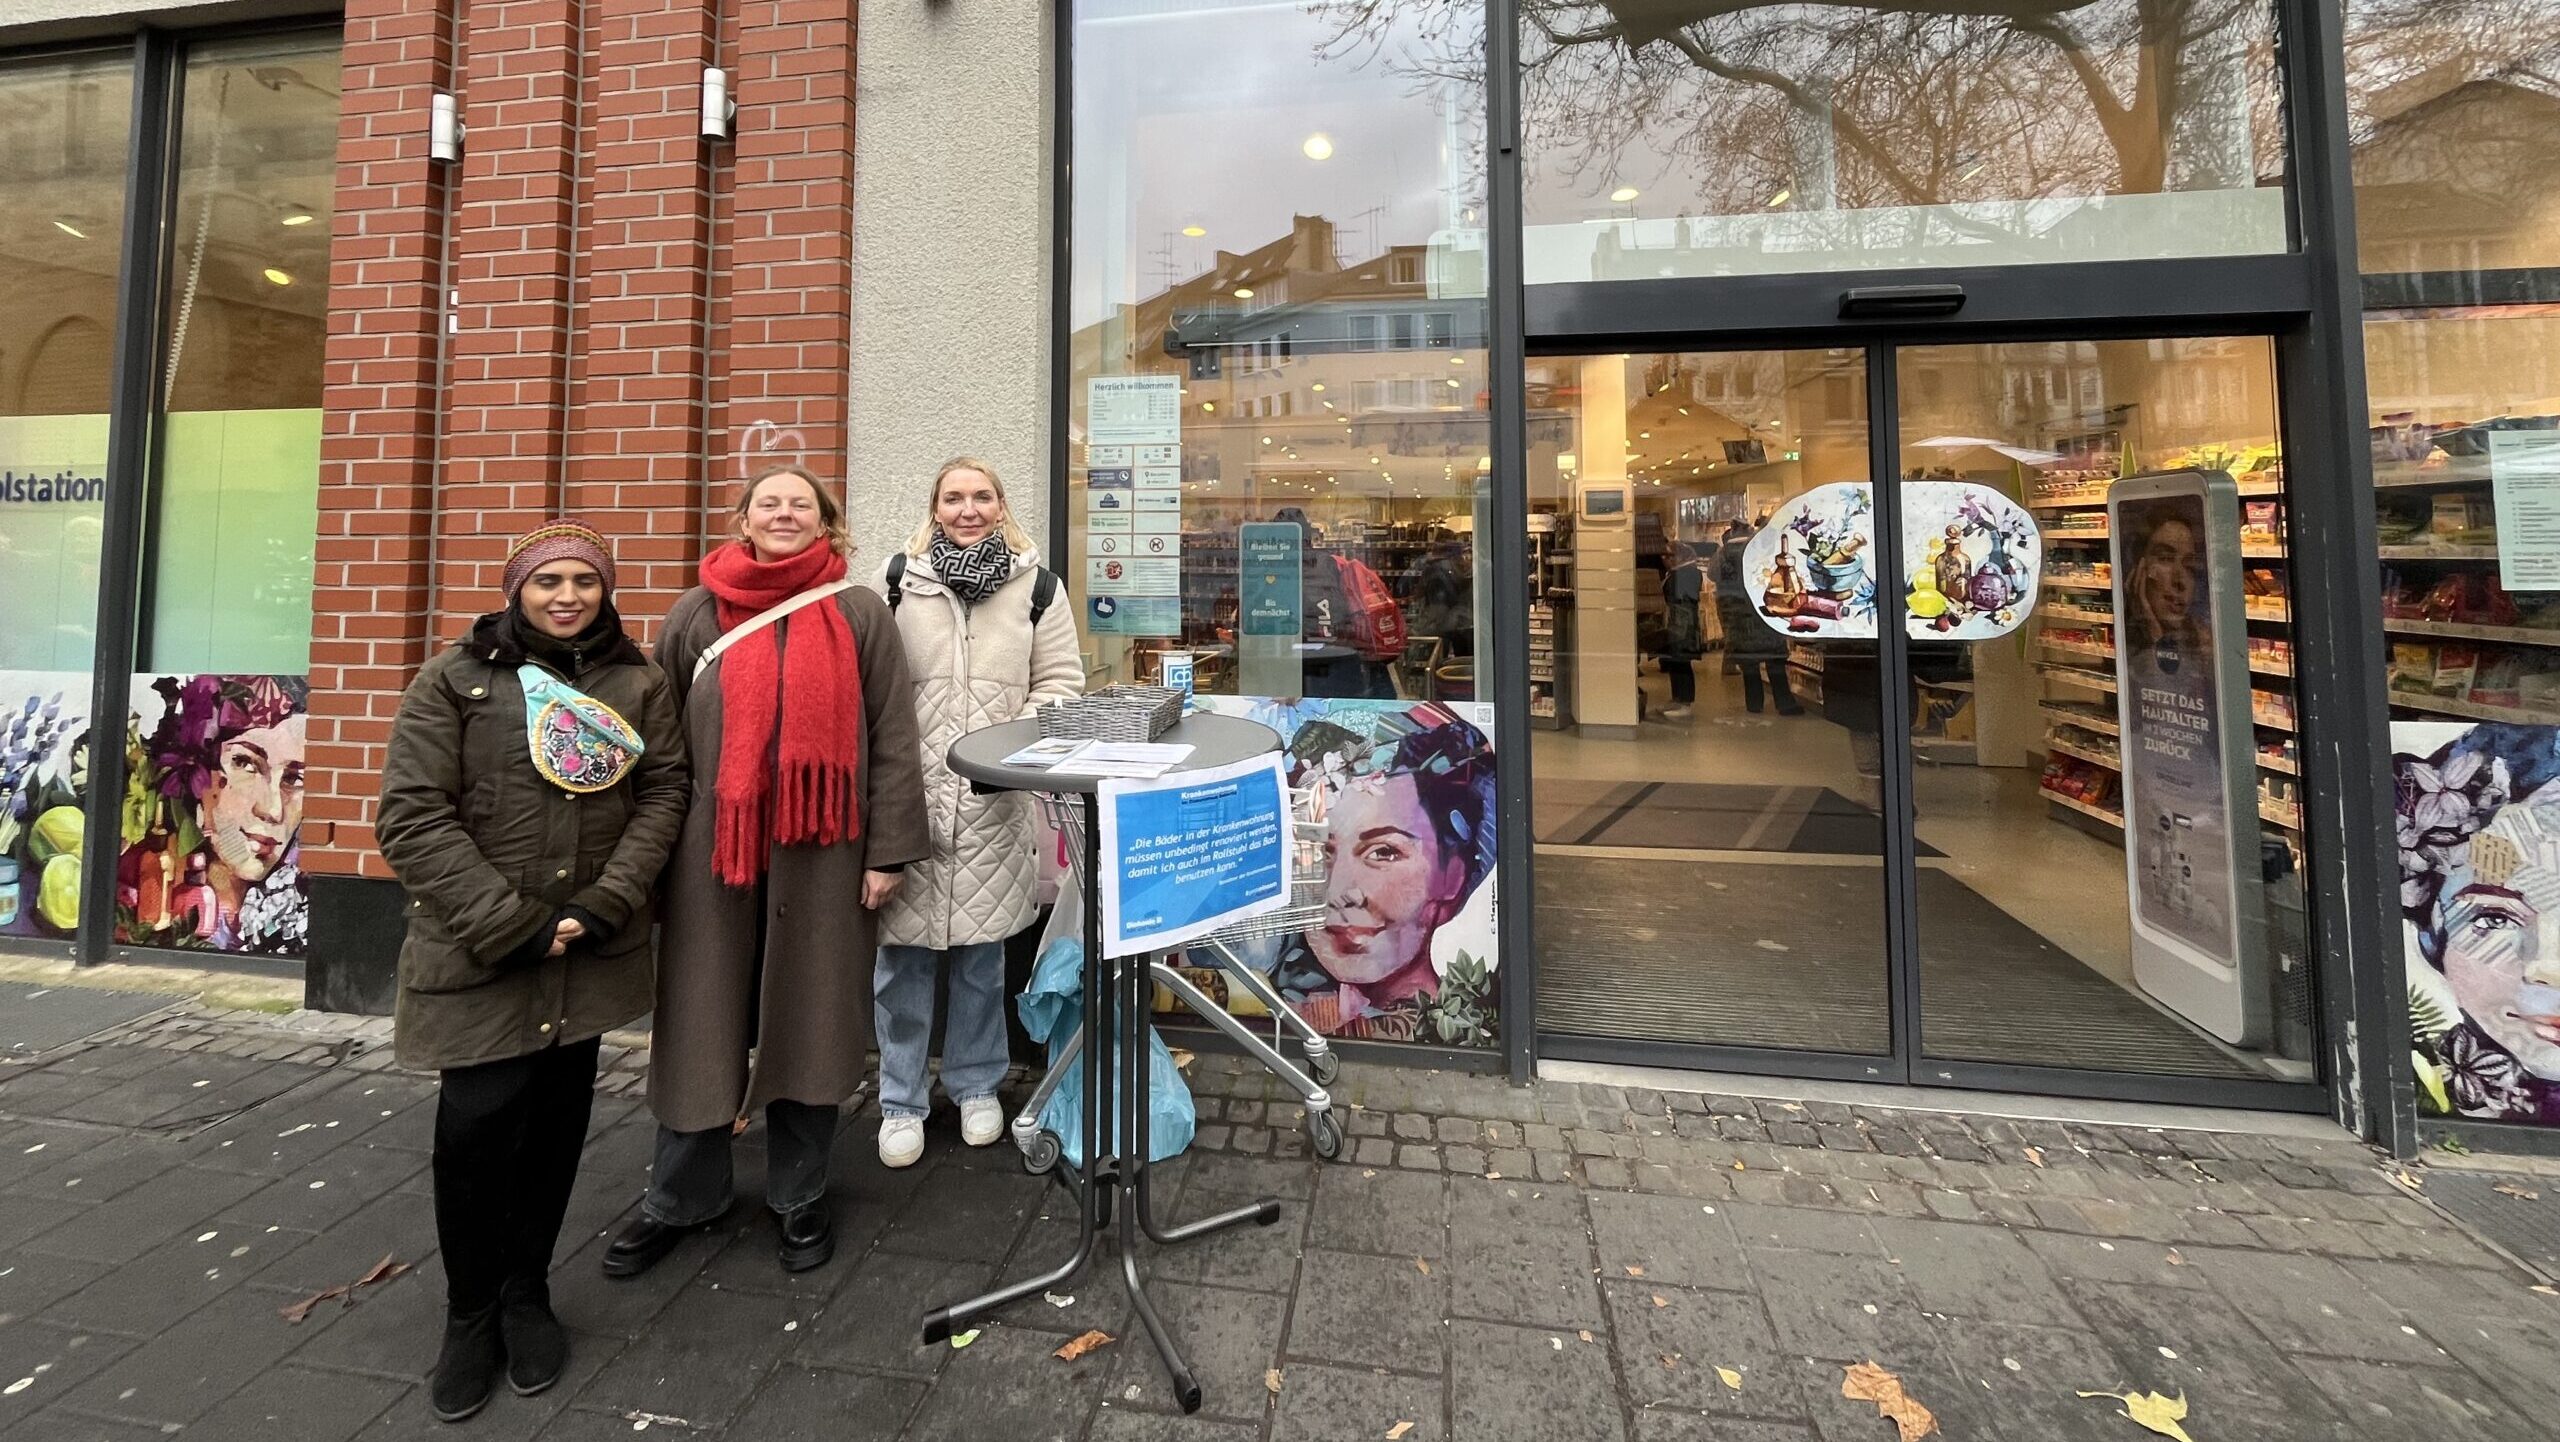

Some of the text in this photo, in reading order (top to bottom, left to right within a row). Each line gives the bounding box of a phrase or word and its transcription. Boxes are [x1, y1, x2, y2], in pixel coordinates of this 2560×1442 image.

[1094, 380, 1174, 391] Herzlich willkommen
[0, 470, 104, 502] lstation
[2156, 650, 2179, 662] NIVEA
[2140, 688, 2205, 712] SETZT DAS
[2141, 704, 2210, 732] HAUTALTER
[2143, 736, 2191, 761] ZURÜCK
[1155, 833, 1183, 847] Bäder
[1185, 831, 1195, 840] in
[1196, 828, 1211, 839] der
[1212, 811, 1275, 834] Krankenwohnung
[1124, 851, 1162, 865] müssen
[1164, 841, 1209, 859] unbedingt
[1211, 831, 1248, 848] renoviert
[1127, 834, 1277, 879] damit ich auch im Rollstuhl das Bad
[1175, 866, 1215, 885] benutzen
